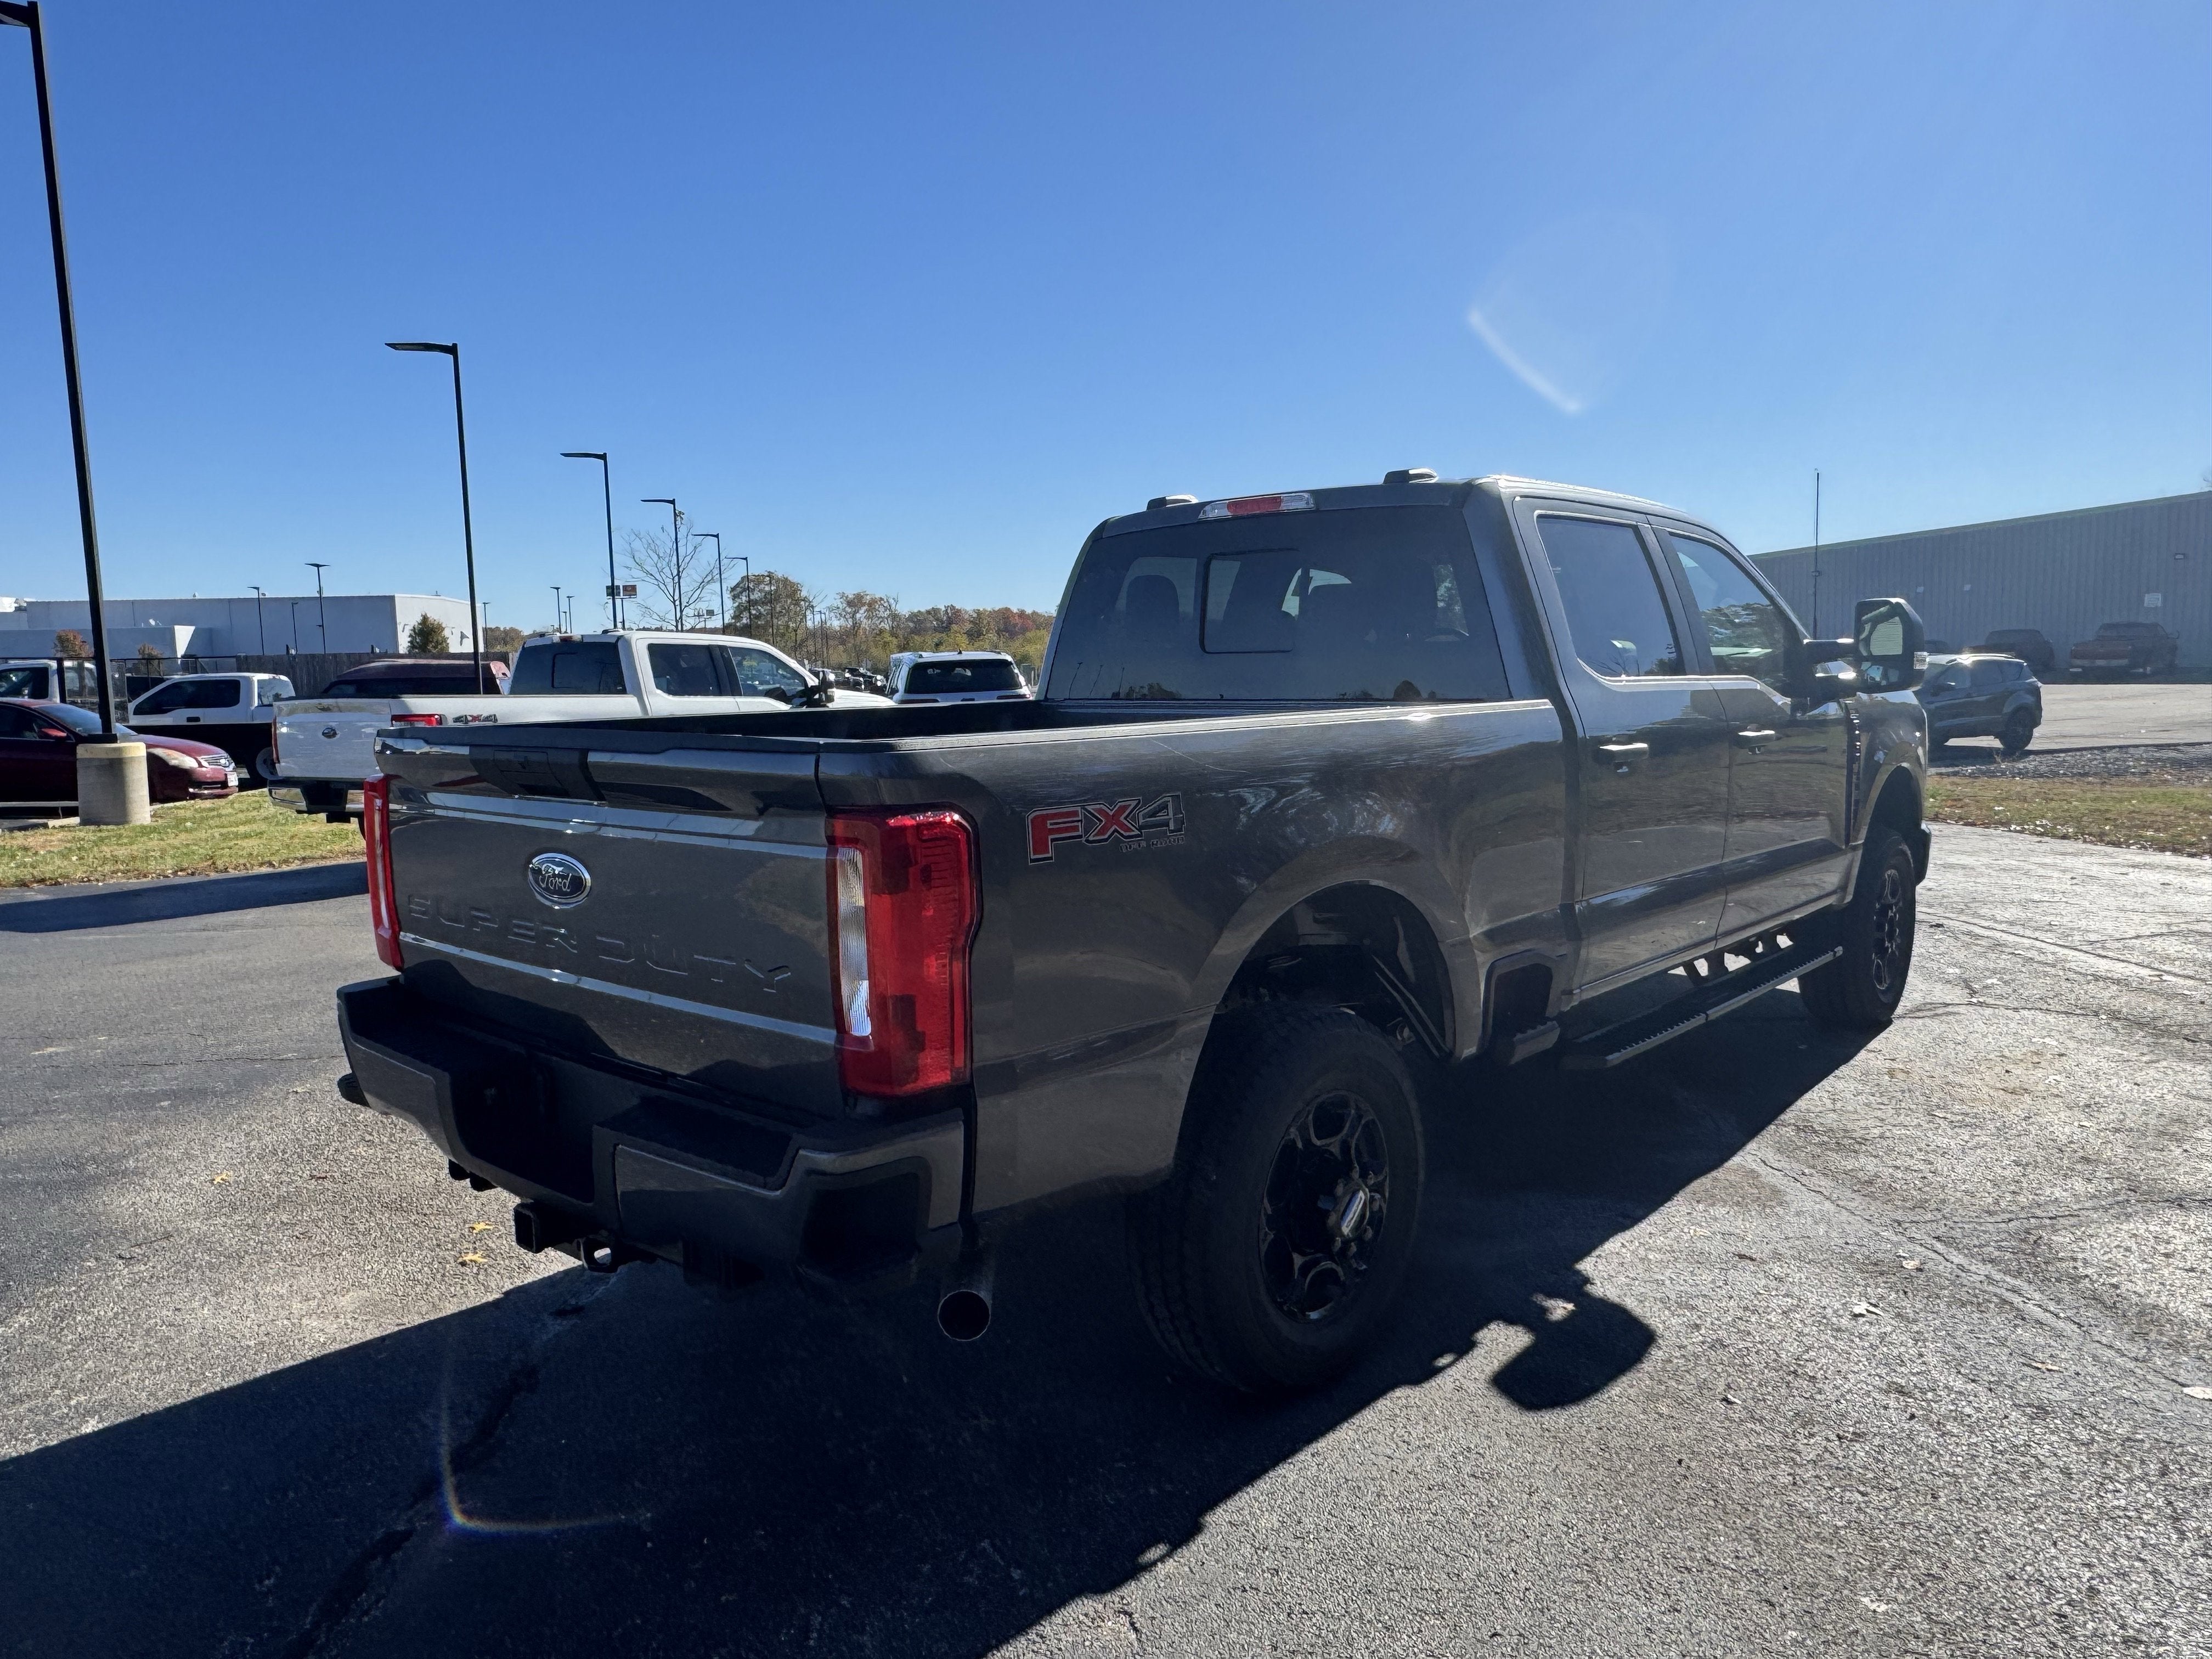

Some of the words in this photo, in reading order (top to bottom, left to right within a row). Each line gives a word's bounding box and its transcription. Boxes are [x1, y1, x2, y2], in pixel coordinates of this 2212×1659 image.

[1025, 792, 1186, 865] FX4
[538, 862, 572, 892] Ford
[408, 895, 578, 953] SUPER
[595, 934, 791, 992] DUTY
